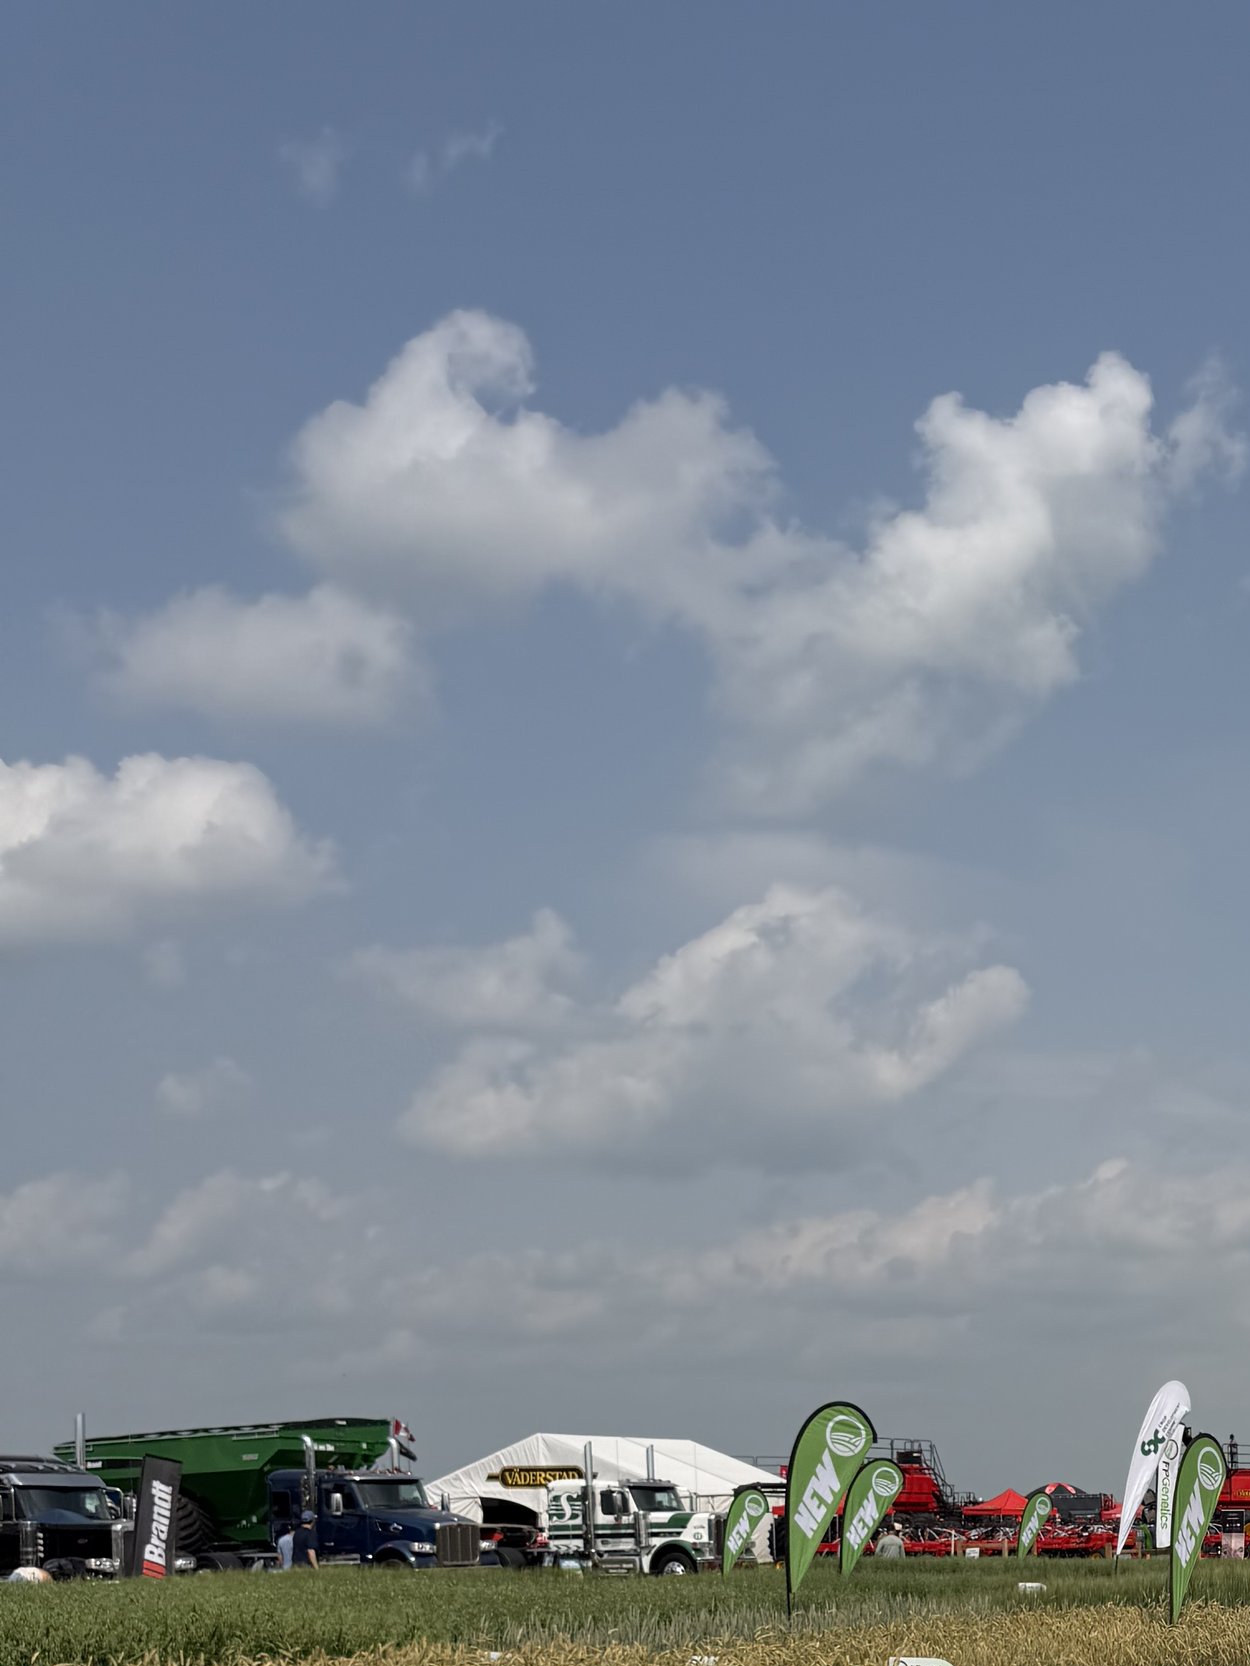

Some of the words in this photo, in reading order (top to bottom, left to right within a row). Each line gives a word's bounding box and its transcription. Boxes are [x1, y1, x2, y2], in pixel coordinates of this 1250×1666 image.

[144, 1479, 173, 1566] Brandt
[794, 1447, 841, 1540] NEW
[846, 1488, 879, 1551] NEW
[1160, 1460, 1173, 1530] FPGenetics
[1175, 1476, 1205, 1569] NEW
[727, 1511, 750, 1555] NEW
[1021, 1510, 1040, 1548] NEW
